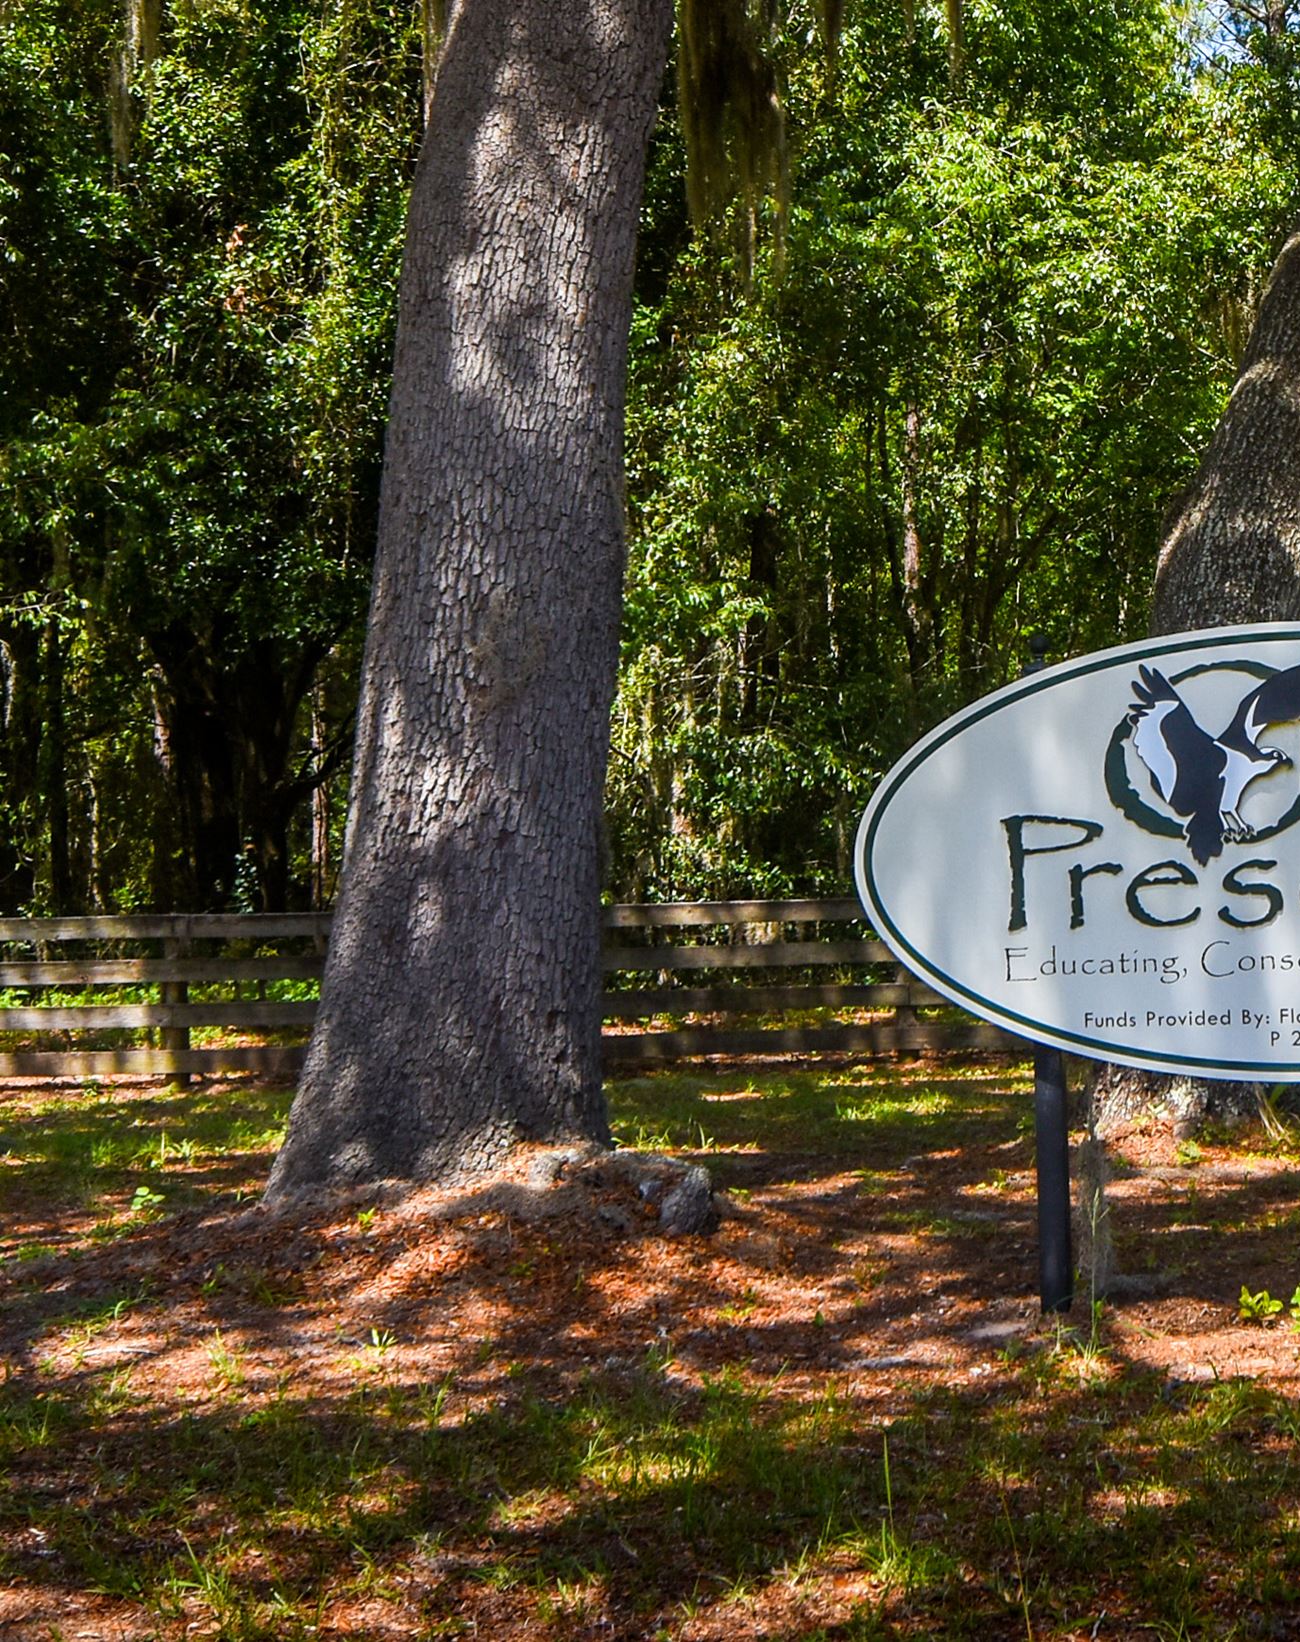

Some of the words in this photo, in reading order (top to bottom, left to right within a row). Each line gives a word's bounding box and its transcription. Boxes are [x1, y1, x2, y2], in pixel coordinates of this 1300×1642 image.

[1004, 945, 1188, 985] Educating,
[1084, 1011, 1137, 1029] Funds
[1146, 1009, 1232, 1027] Provided
[1241, 1009, 1271, 1029] By:
[1270, 1031, 1281, 1047] P
